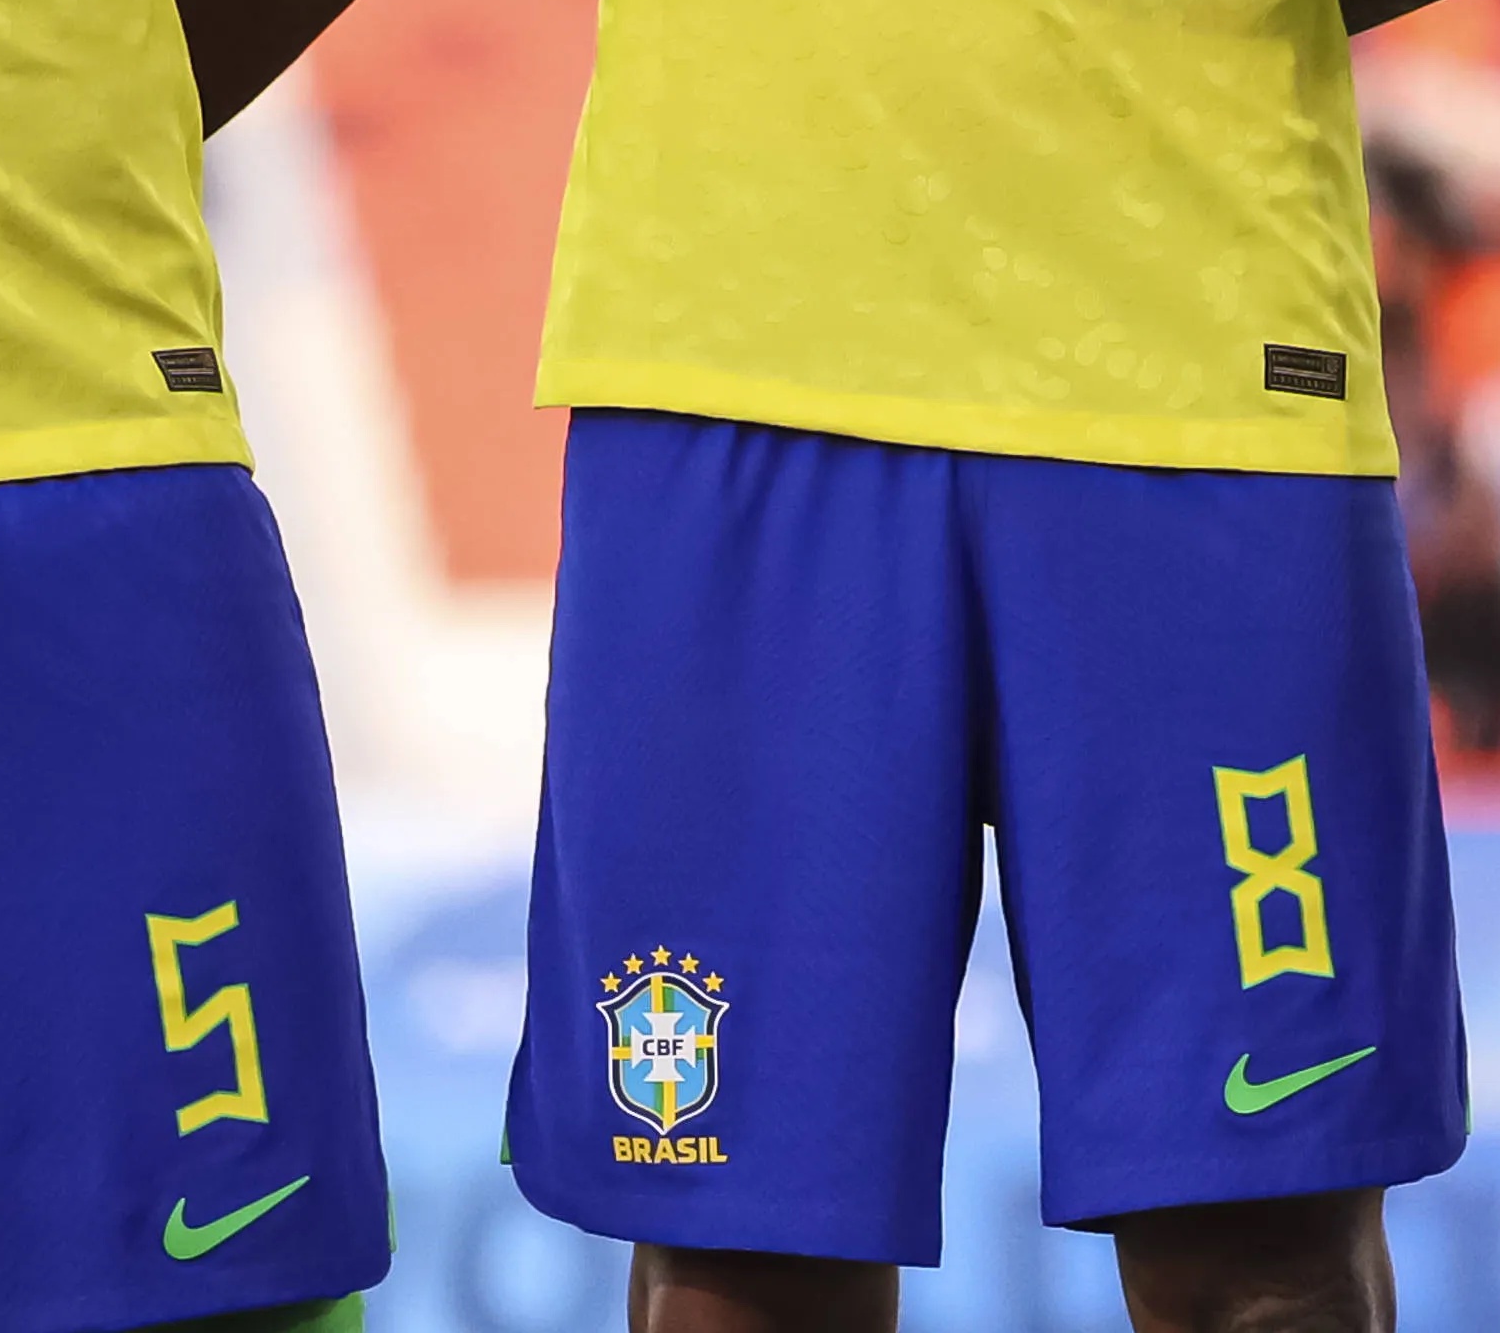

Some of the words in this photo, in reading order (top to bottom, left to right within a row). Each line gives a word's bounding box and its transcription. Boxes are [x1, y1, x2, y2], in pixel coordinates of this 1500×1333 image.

[1212, 753, 1336, 991] 8
[145, 899, 270, 1138] 5
[642, 1038, 685, 1057] CBF
[612, 1135, 729, 1165] BRASIL
